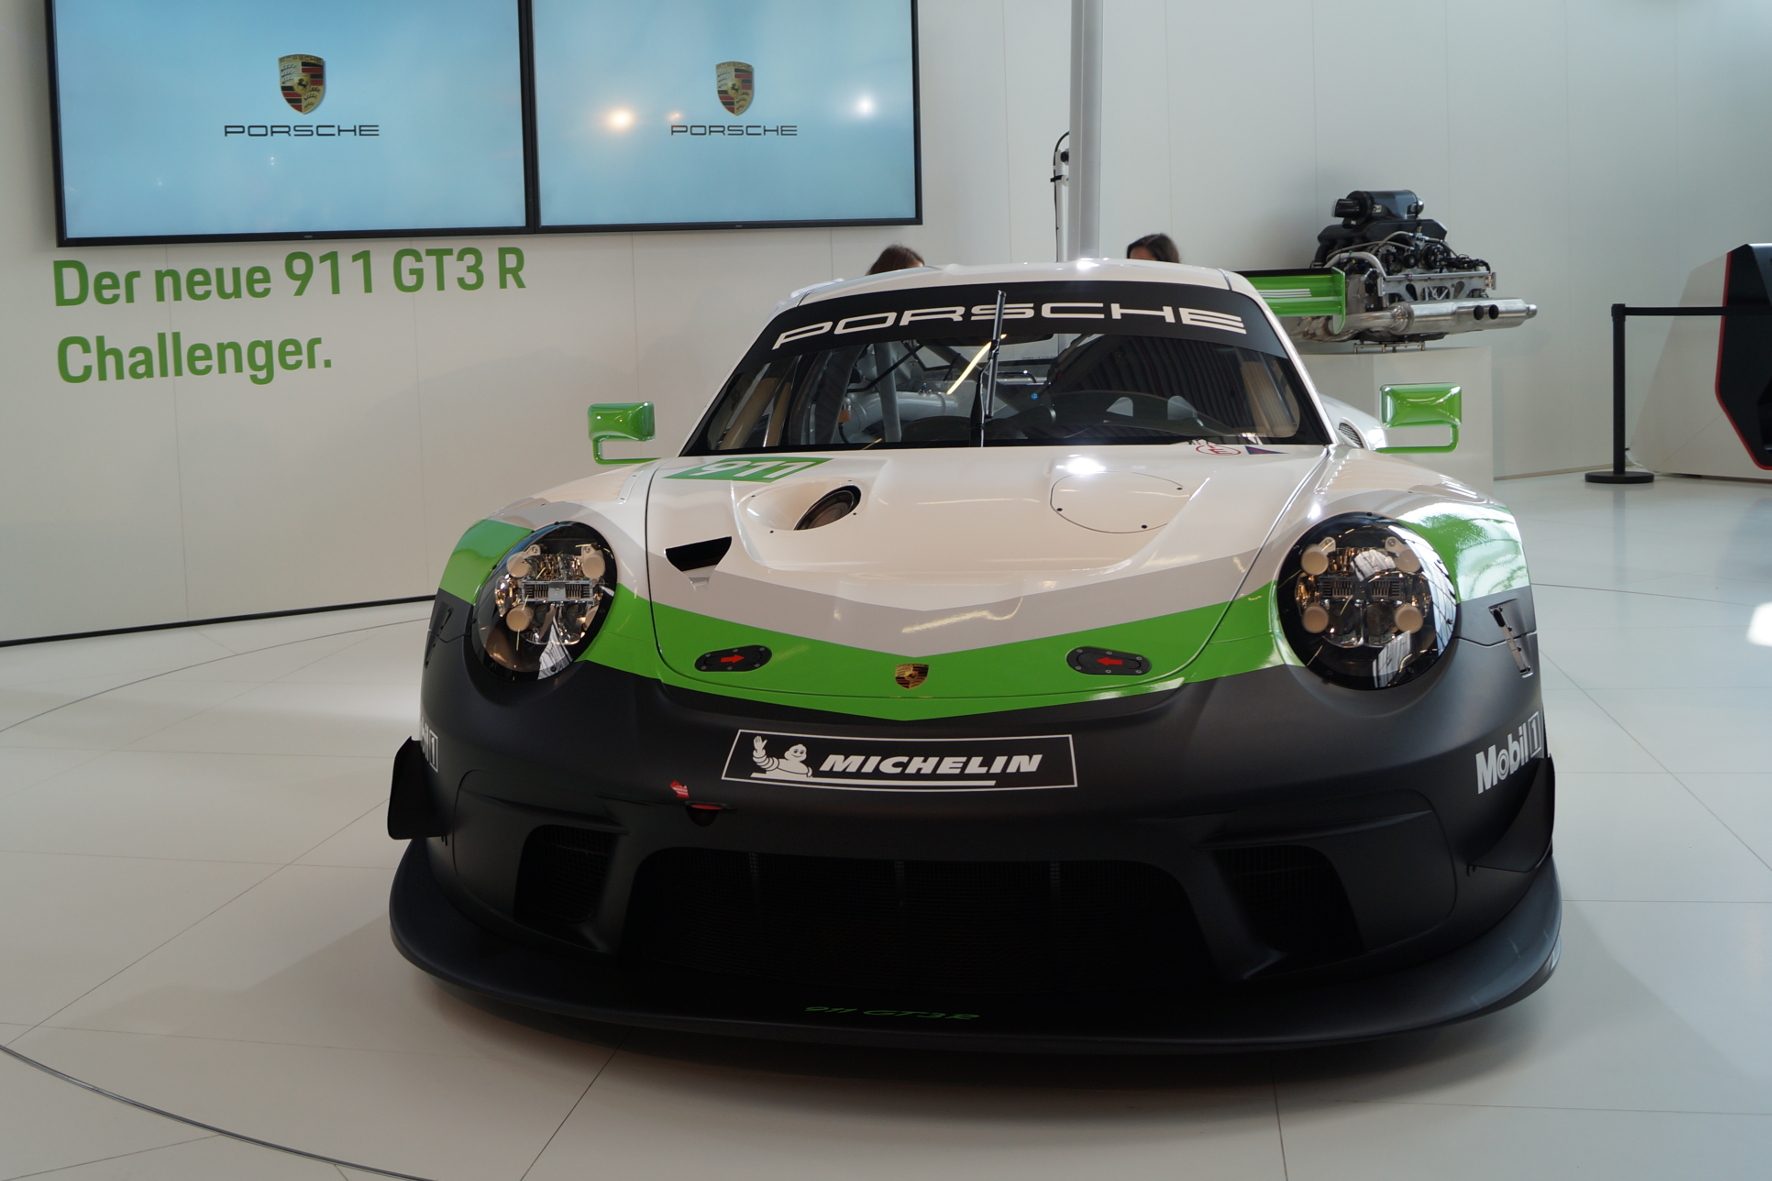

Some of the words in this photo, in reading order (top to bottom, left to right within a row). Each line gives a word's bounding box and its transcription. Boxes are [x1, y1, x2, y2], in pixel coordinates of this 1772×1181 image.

[224, 125, 380, 137] PORSCHE
[671, 125, 798, 136] PORSCHE
[54, 260, 141, 307] Der
[155, 265, 271, 302] neue
[285, 250, 373, 297] 911
[393, 247, 484, 293] GT3
[498, 246, 527, 290] R
[771, 302, 1247, 351] PORSCHE
[57, 332, 332, 386] Challenger.
[687, 460, 817, 479] 911
[818, 754, 1043, 775] MICHELIN
[1475, 722, 1529, 795] Mobil
